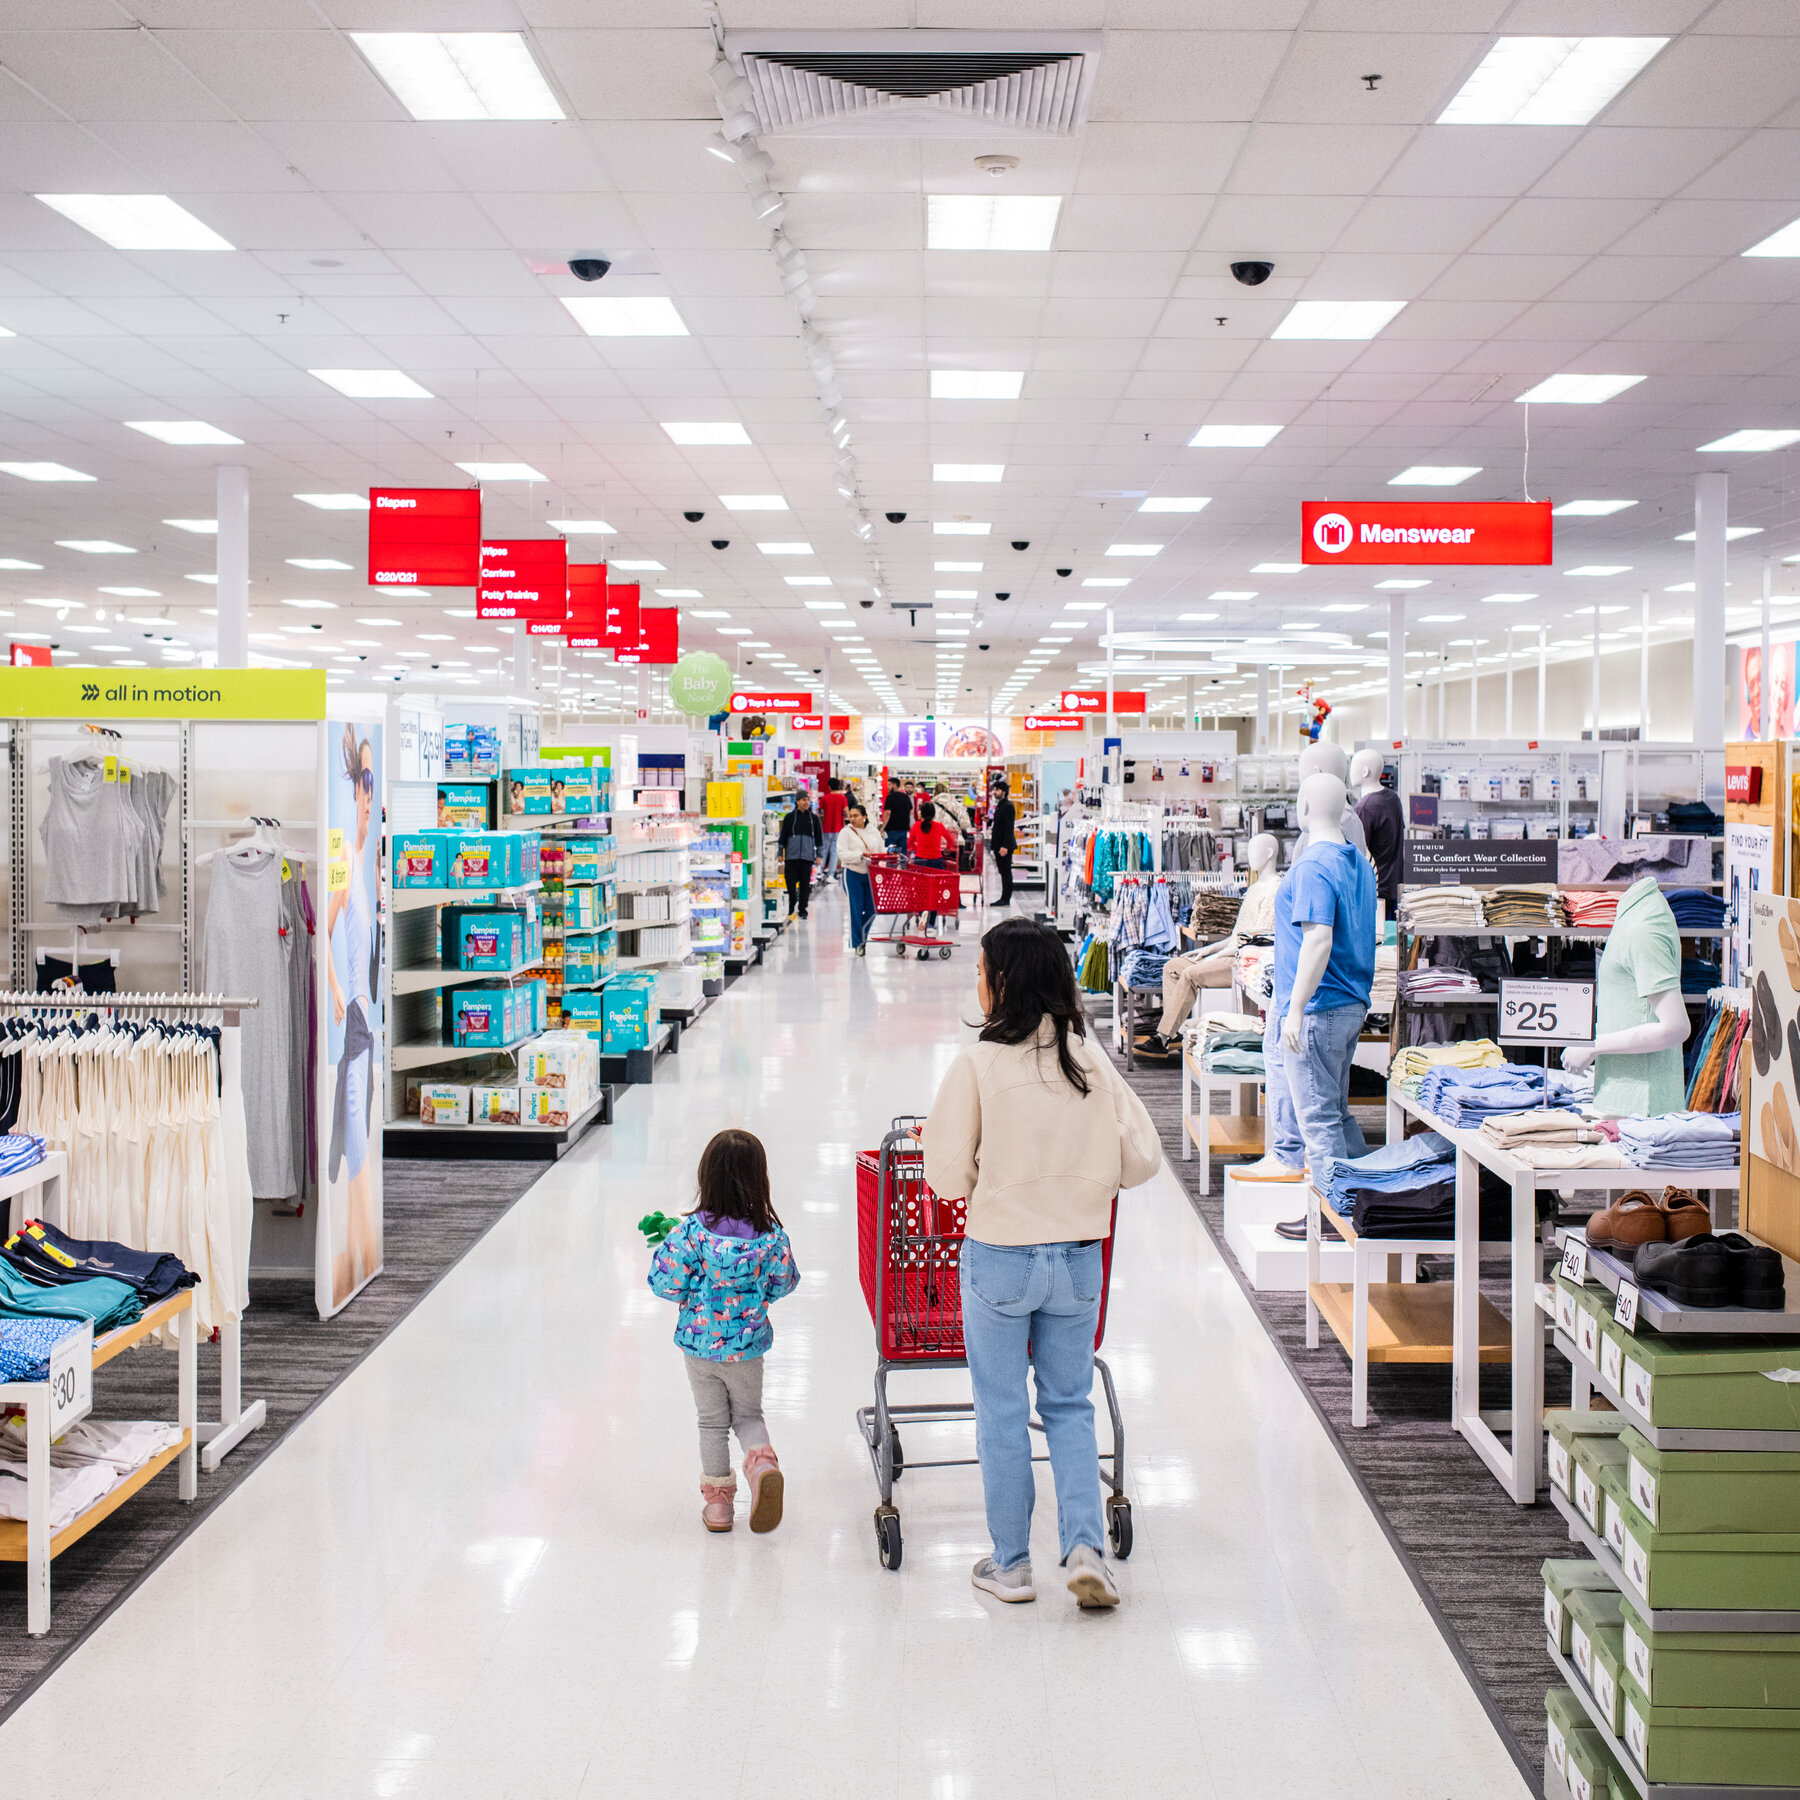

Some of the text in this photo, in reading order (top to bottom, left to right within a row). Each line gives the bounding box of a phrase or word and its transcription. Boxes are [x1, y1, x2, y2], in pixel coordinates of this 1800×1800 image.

[377, 497, 416, 509] Diapers
[1360, 524, 1474, 543] Menswear
[482, 547, 508, 557] Wipes
[376, 572, 417, 582] Q20/Q21
[482, 569, 515, 577] Carriers
[482, 590, 538, 600] Potty Training
[692, 664, 709, 674] The
[683, 678, 718, 691] Baby
[106, 685, 220, 702] all in motion
[688, 692, 714, 703] Nook
[748, 699, 800, 708] Toys & Games
[1079, 698, 1099, 706] Tech
[524, 776, 548, 785] Pampers
[565, 776, 588, 784] Pampers
[449, 792, 480, 804] Pampers
[404, 841, 435, 852] Pampers
[460, 842, 491, 853] Pampers
[1732, 835, 1768, 851] FIND YOUR FIT
[572, 845, 593, 853] Pampers
[1413, 854, 1546, 862] The Comfort Wear Collection
[336, 867, 345, 884] train
[471, 925, 499, 935] Pampers
[566, 943, 590, 953] Pampers
[463, 1001, 492, 1012] Pampers
[573, 1008, 598, 1017] Pampers
[610, 1011, 639, 1022] Pampers
[1506, 1000, 1557, 1031] $25
[526, 1056, 534, 1082] Pampers
[432, 1090, 456, 1098] Pampers
[480, 1094, 488, 1119] Pampers
[528, 1093, 537, 1119] Pampers
[1564, 1252, 1579, 1276] $40
[1618, 1294, 1631, 1321] $40
[53, 1367, 75, 1409] $30
